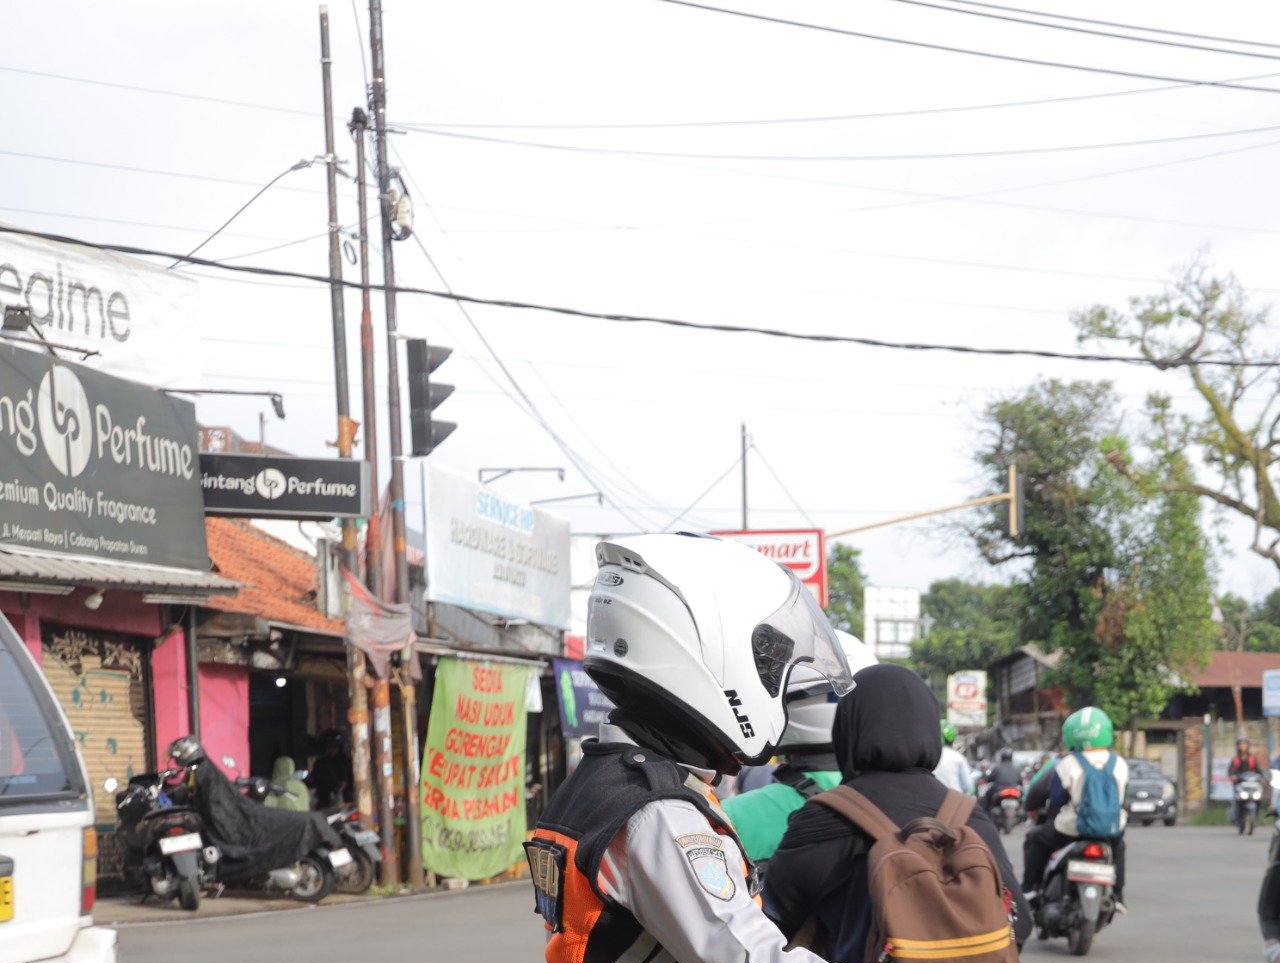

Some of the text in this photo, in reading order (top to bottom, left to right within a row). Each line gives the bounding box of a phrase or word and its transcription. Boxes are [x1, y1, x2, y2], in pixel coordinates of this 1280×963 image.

[96, 404, 194, 480] Perfume
[43, 482, 94, 518] Quality
[96, 491, 157, 524] Fragrance
[200, 473, 357, 497] intang Perfume
[723, 689, 755, 739] NJS
